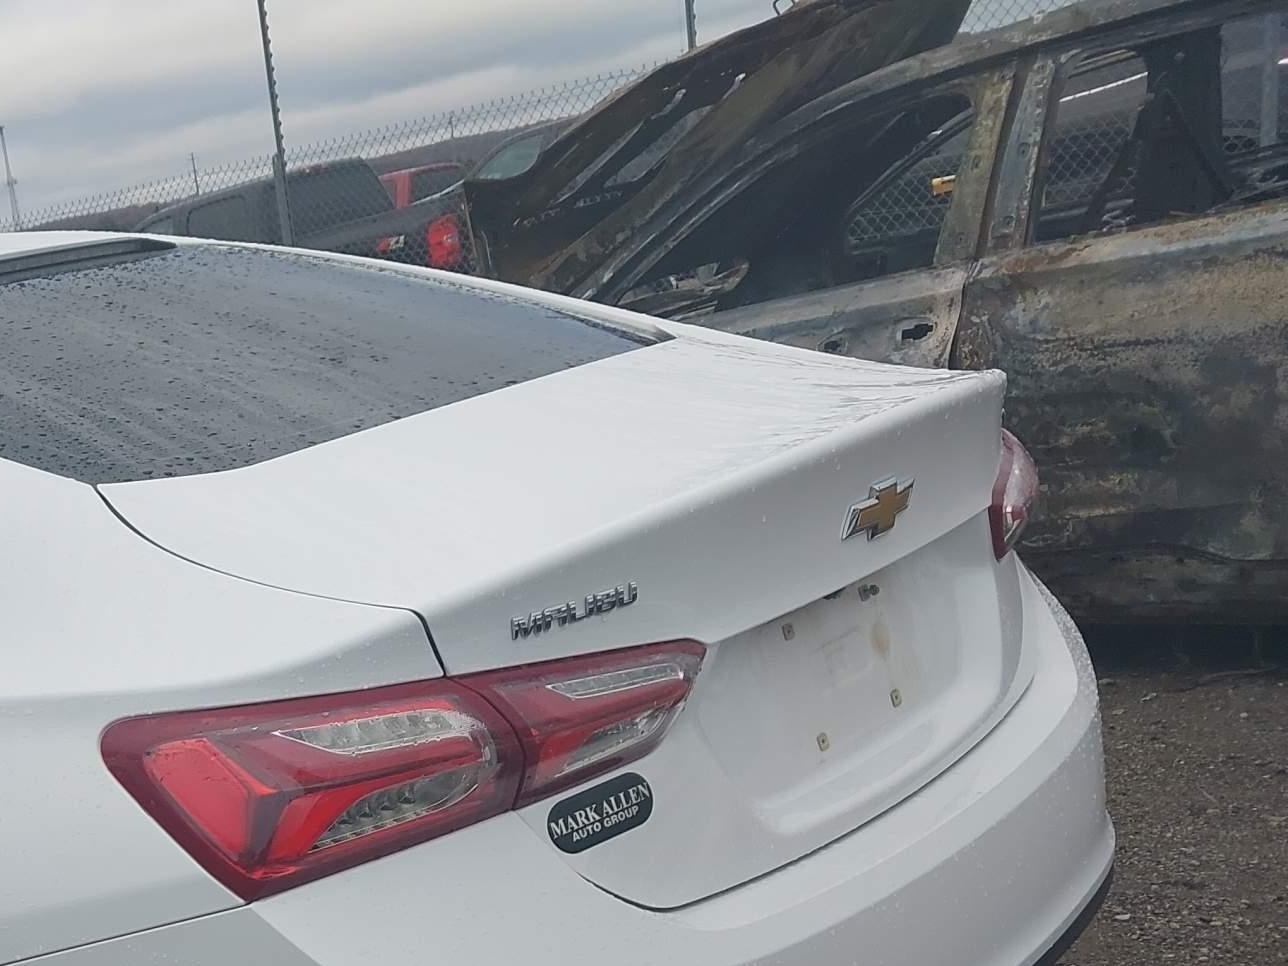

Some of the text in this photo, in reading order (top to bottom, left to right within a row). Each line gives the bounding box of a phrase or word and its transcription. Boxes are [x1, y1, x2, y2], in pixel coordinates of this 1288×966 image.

[510, 581, 638, 640] MALIBU
[549, 782, 650, 840] MARK ALLEN
[572, 805, 639, 842] AUTO GROUP
